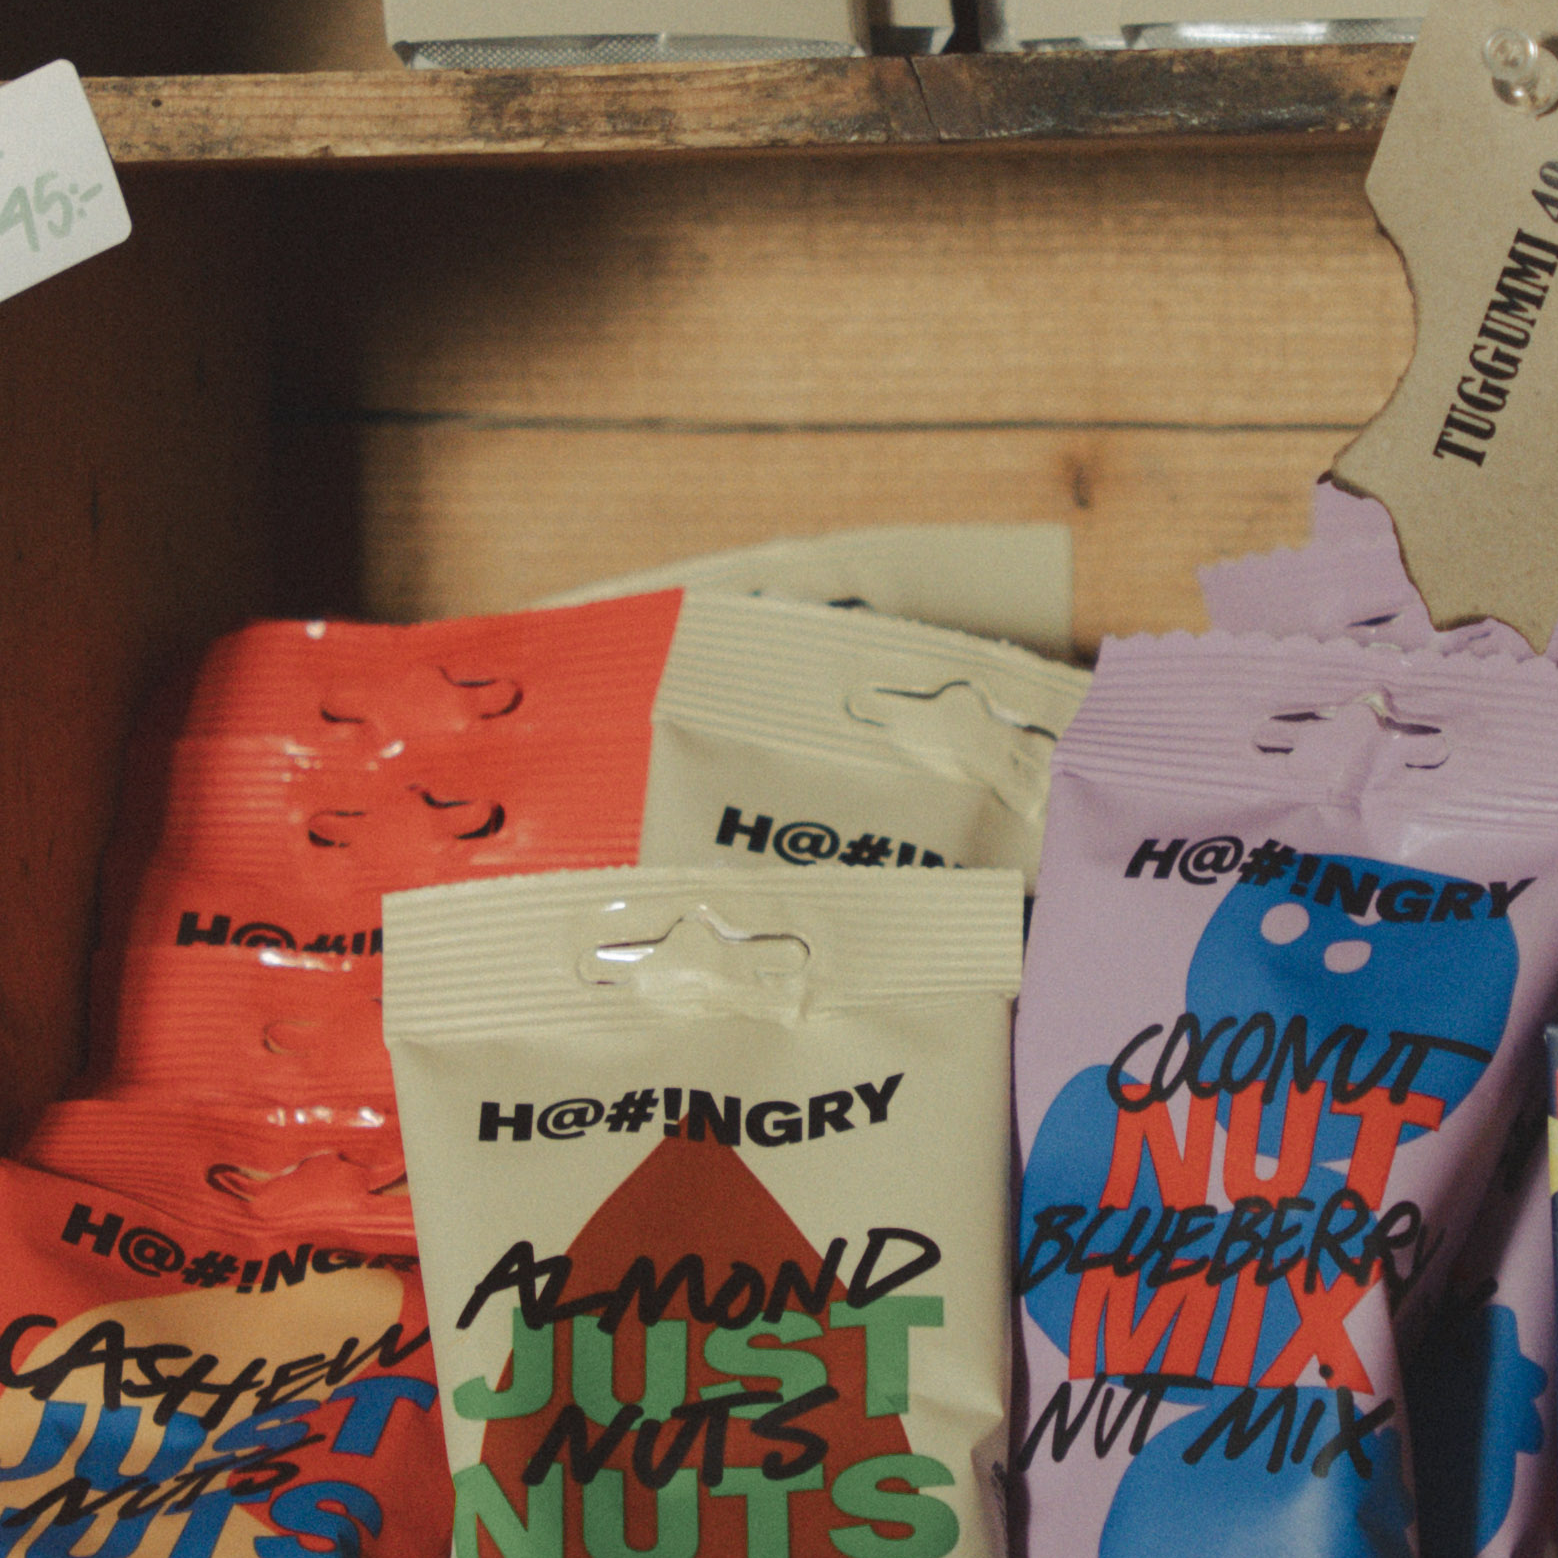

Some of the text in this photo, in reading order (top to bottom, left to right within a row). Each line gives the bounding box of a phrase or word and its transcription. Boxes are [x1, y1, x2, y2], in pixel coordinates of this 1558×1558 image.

[1124, 835, 1539, 925] H@#!NGRY
[478, 1072, 906, 1150] H@#!NGRY
[1106, 1009, 1494, 1114] COCONUT
[1098, 1080, 1446, 1212] NUT
[60, 1202, 420, 1295] H@#!NGR
[456, 1225, 942, 1333] ALMOND
[1017, 1187, 1447, 1319] BLUEBERRY
[0, 1313, 433, 1431] CASHEW
[452, 1295, 945, 1426] JUST
[1068, 1255, 1388, 1397] MIX
[522, 1385, 840, 1493] NUTS
[1018, 1365, 1398, 1479] NUT MIX
